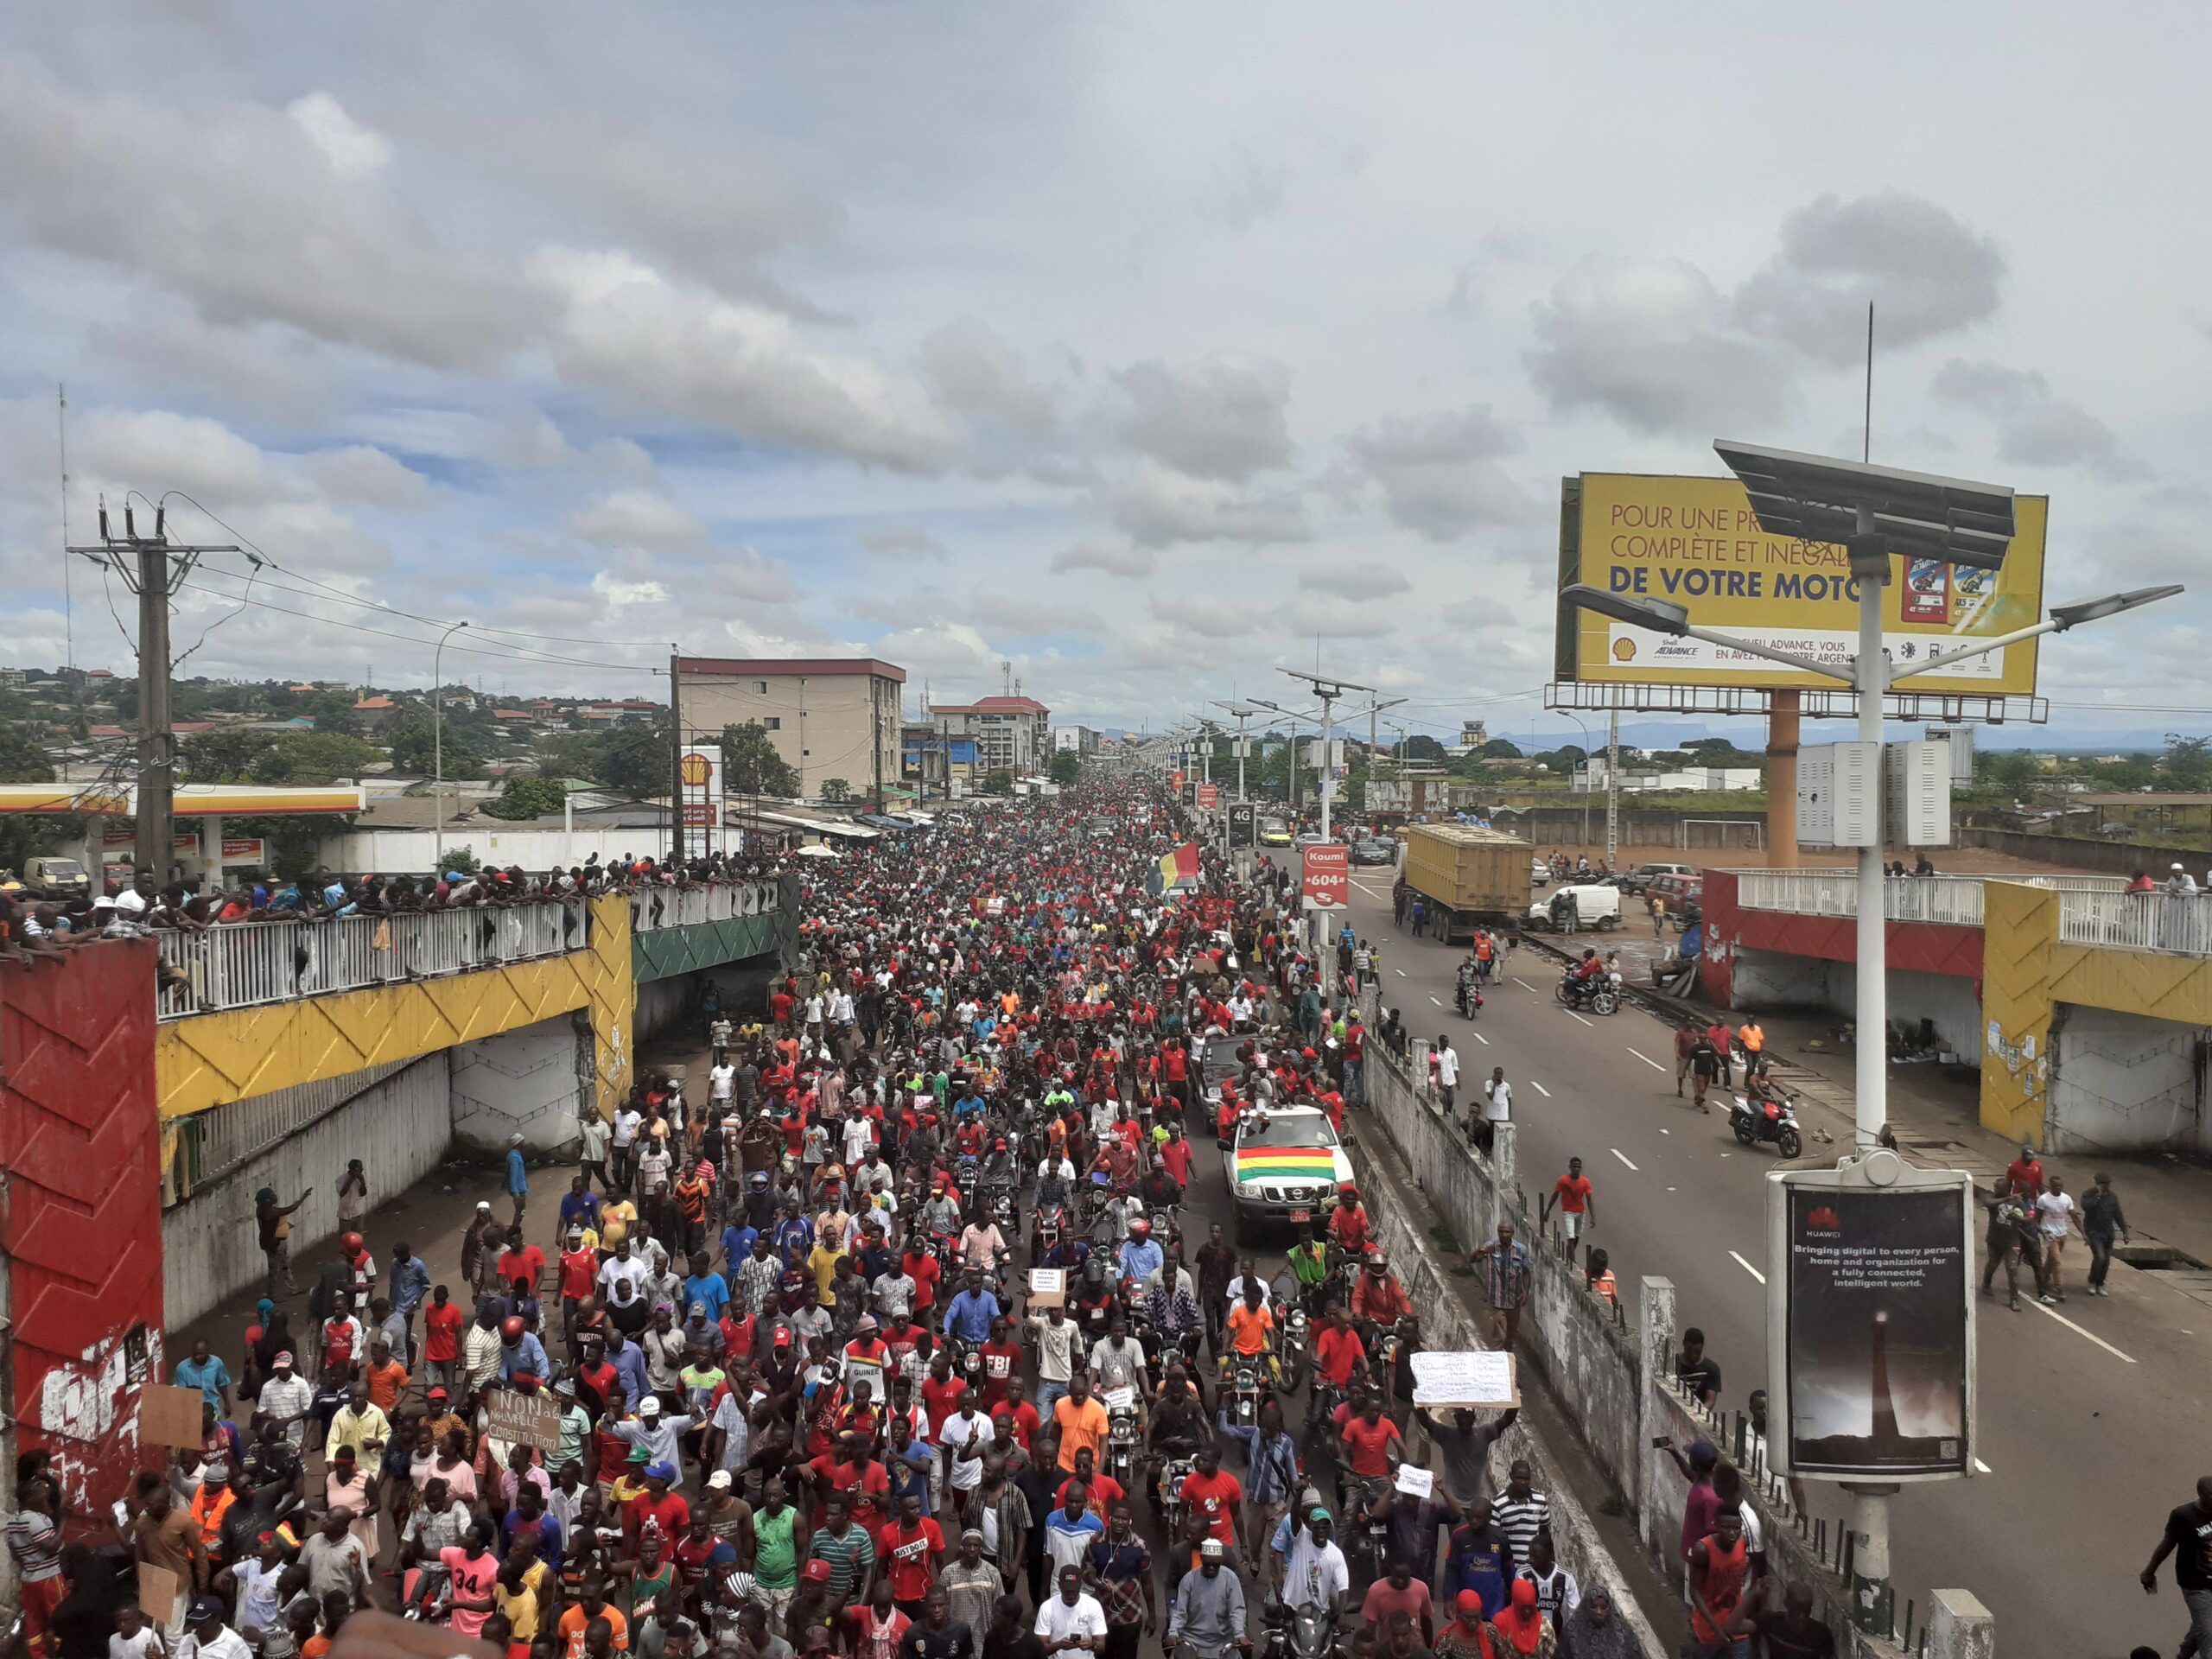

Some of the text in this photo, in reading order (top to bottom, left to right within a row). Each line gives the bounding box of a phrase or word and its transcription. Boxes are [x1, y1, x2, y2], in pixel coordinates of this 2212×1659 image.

[1611, 505, 1672, 529] POUR
[1681, 508, 1728, 531] UNE
[1611, 532, 1852, 568] COMPLÈTE ET INÉGAL
[1610, 566, 1648, 593] DE
[1659, 568, 1762, 598] VOTRE
[1655, 646, 1700, 656] ADVANCE
[1770, 639, 1816, 652] ADVANCE,
[1819, 641, 1846, 652] VOUS
[1715, 649, 1728, 659] EN
[1731, 650, 1755, 660] AVEZ
[1234, 810, 1250, 821] 4G
[1309, 852, 1344, 861] Koumi
[1795, 1244, 1840, 1256] Bringing
[1842, 1247, 1876, 1256] digital
[1923, 1246, 1960, 1255] person,
[1809, 1256, 1840, 1265] home
[1865, 1257, 1929, 1268] organization
[1841, 1268, 1865, 1278] fully
[1867, 1268, 1926, 1277] connected,
[1834, 1279, 1888, 1288] intelligent
[986, 1355, 1011, 1370] FBI
[500, 1391, 541, 1416] NON
[490, 1408, 539, 1428] NOUVELLE
[896, 1548, 910, 1557] JUST
[910, 1543, 919, 1552] DO
[455, 1568, 479, 1594] 34
